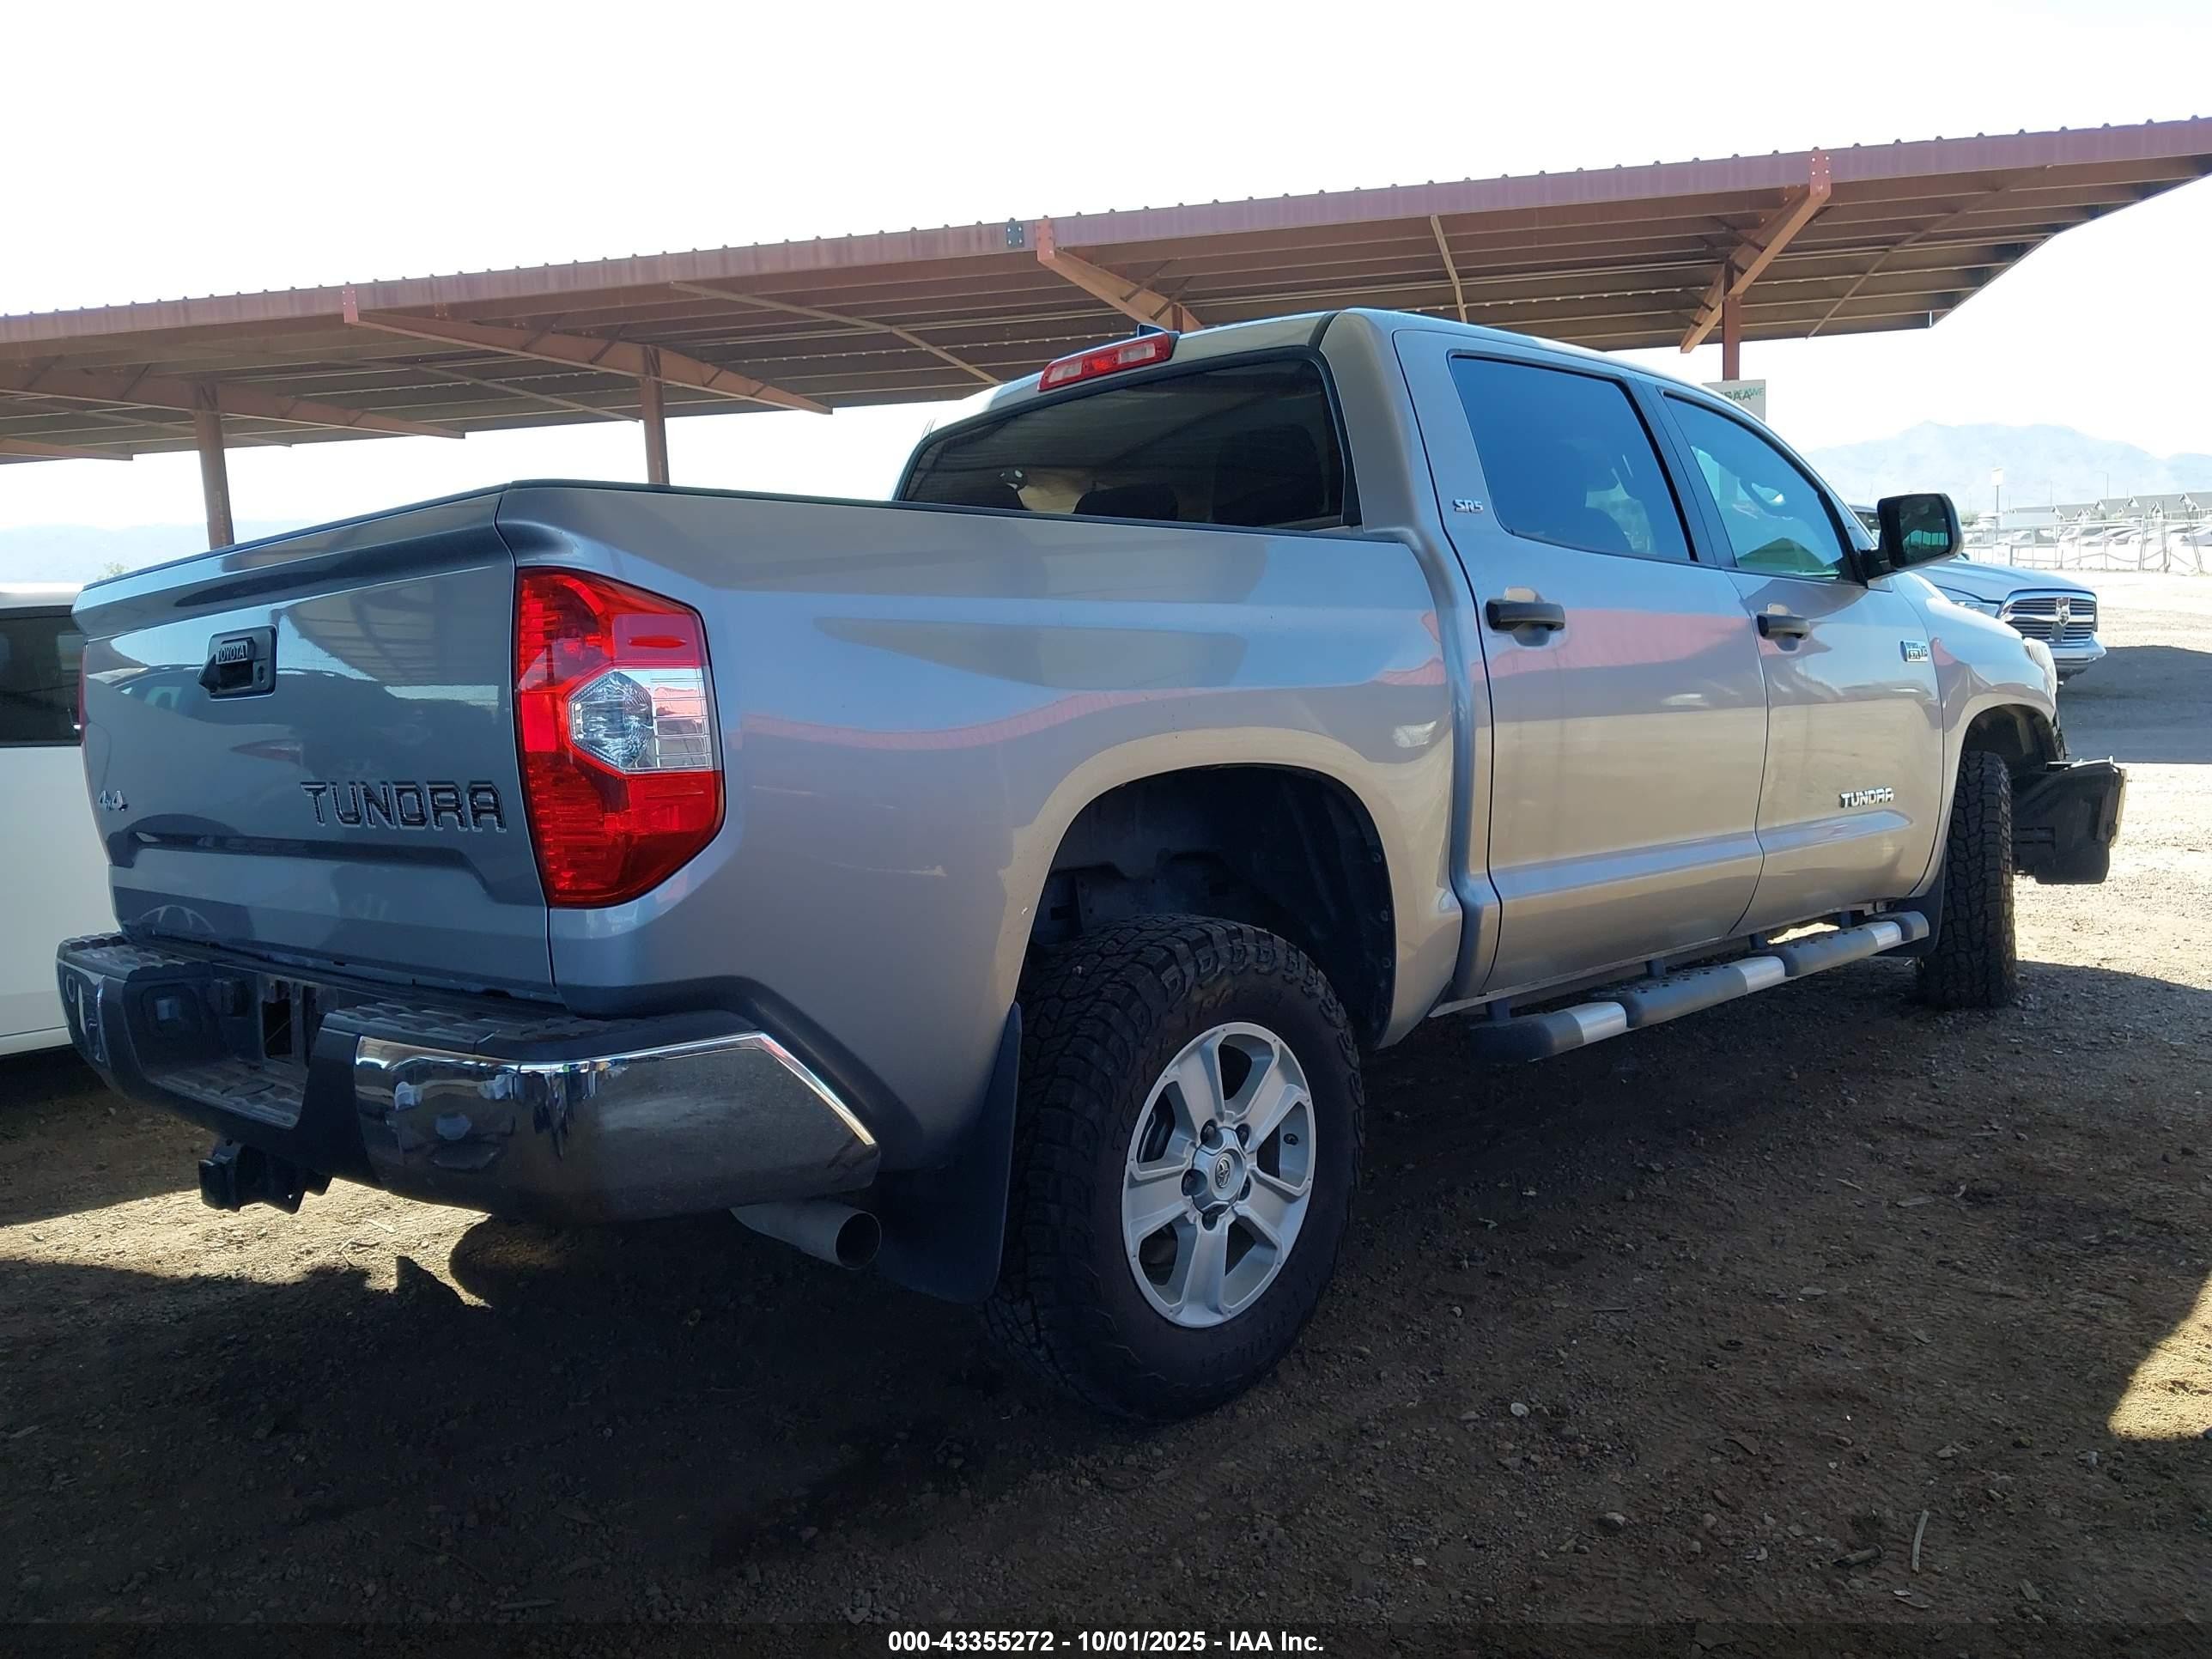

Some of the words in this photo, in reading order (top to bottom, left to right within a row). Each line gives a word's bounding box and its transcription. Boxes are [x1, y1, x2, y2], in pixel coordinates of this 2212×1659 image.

[1453, 499, 1484, 513] SR5
[216, 644, 246, 662] TOYOTA
[301, 781, 507, 832] TUNDRA
[1840, 787, 1894, 808] TUNDRA
